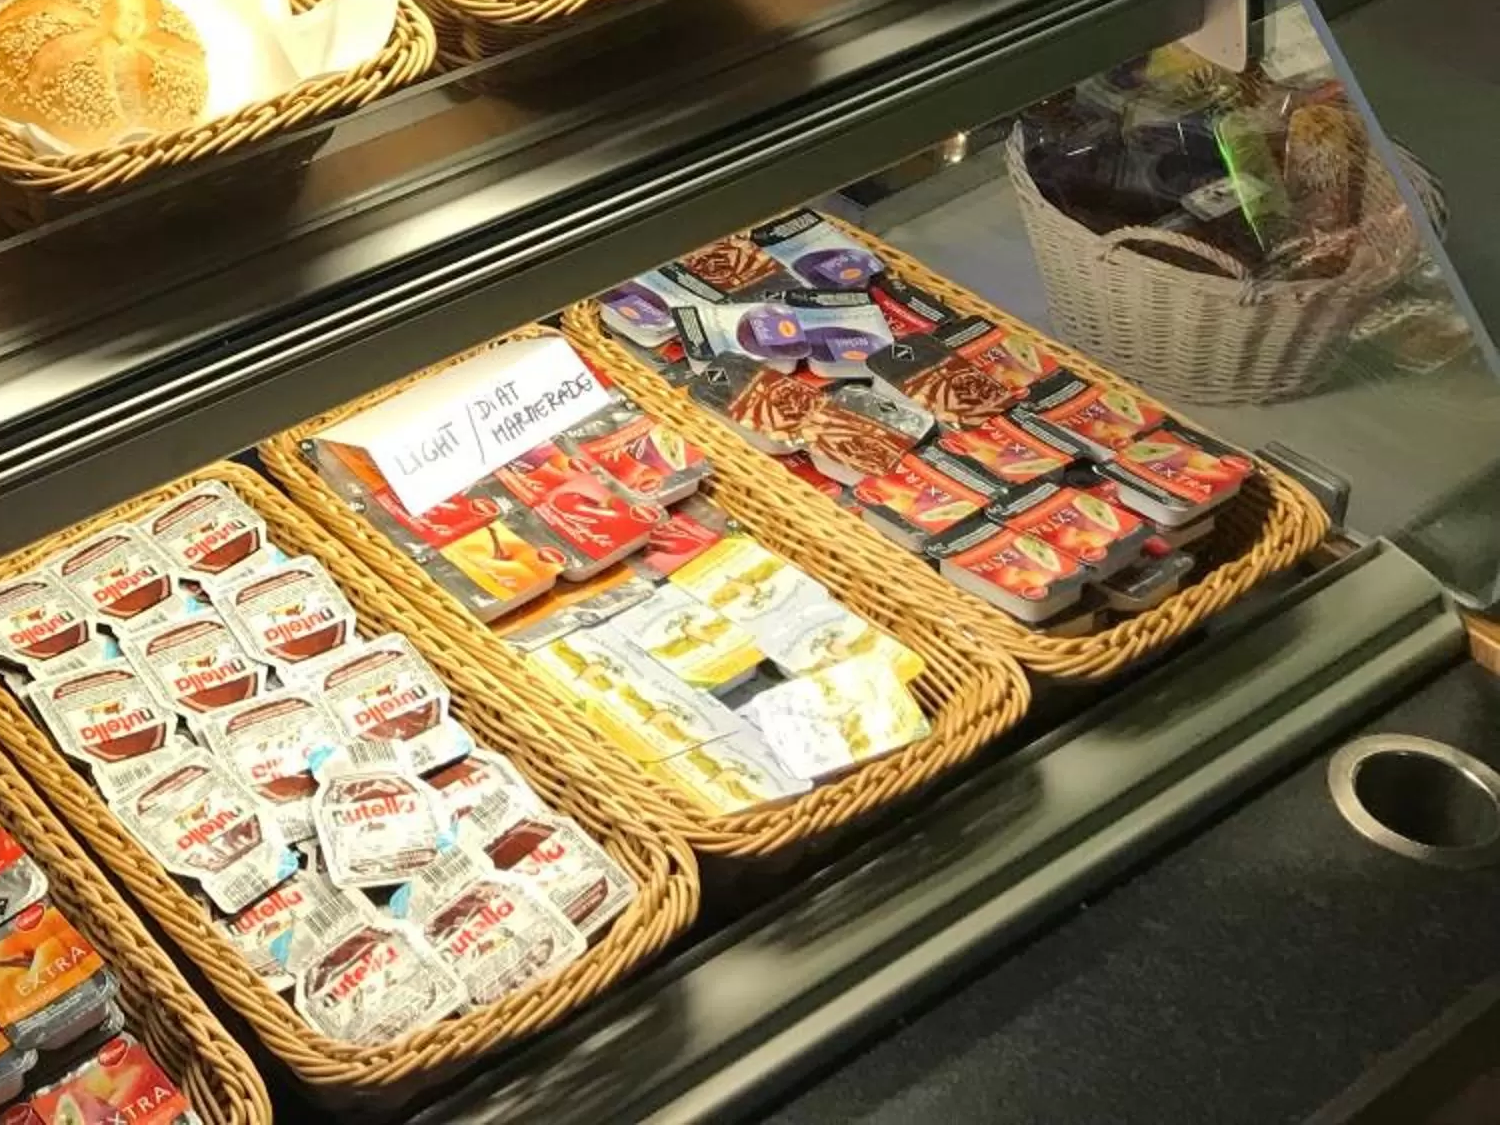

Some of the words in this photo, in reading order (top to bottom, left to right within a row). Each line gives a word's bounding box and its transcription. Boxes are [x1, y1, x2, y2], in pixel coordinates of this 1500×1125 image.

[394, 421, 461, 475] LIGHT
[183, 519, 247, 561] nutella
[93, 566, 157, 606] nutella
[9, 610, 73, 646] nutella
[264, 606, 335, 643] nutella
[175, 657, 247, 695] nutella
[80, 707, 156, 744] nutella
[355, 684, 428, 728] nutella
[176, 806, 243, 851] nutella
[14, 944, 87, 997] EXTRA
[100, 1086, 173, 1125] XTRA
